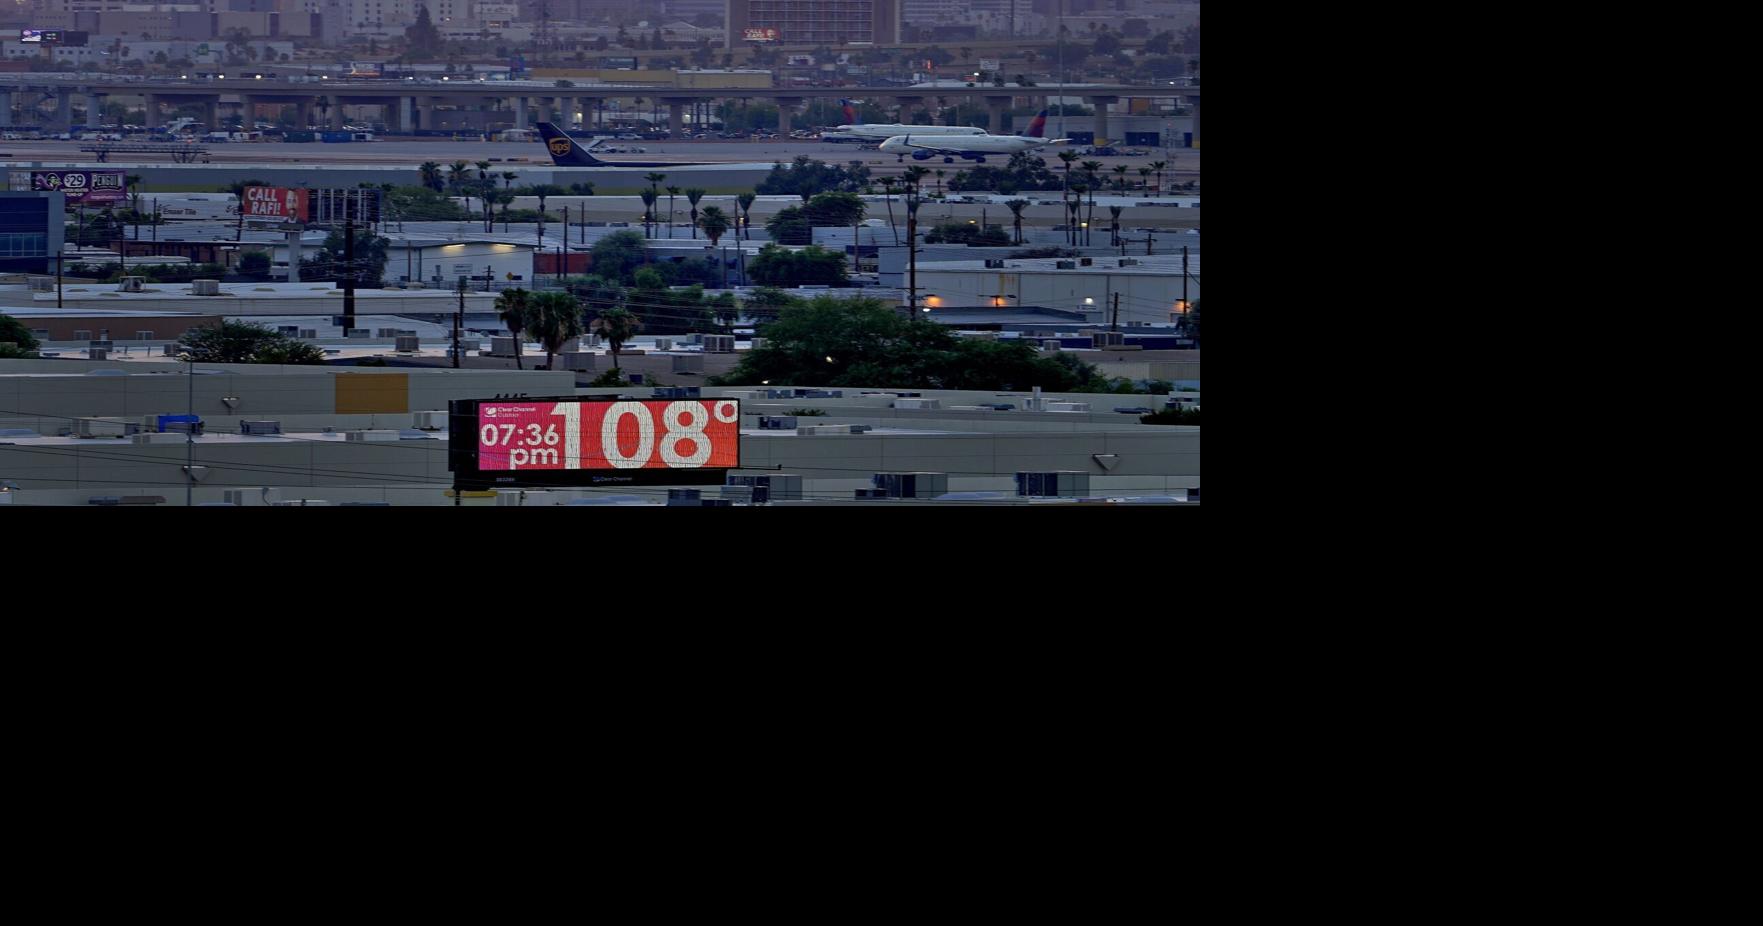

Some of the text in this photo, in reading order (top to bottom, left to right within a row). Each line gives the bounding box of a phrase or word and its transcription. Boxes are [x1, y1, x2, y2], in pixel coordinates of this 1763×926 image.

[551, 143, 569, 154] ups
[65, 174, 83, 188] $29
[247, 188, 278, 202] CALL
[251, 201, 281, 215] RAFI!
[480, 423, 560, 447] 07:36
[509, 448, 559, 470] pm
